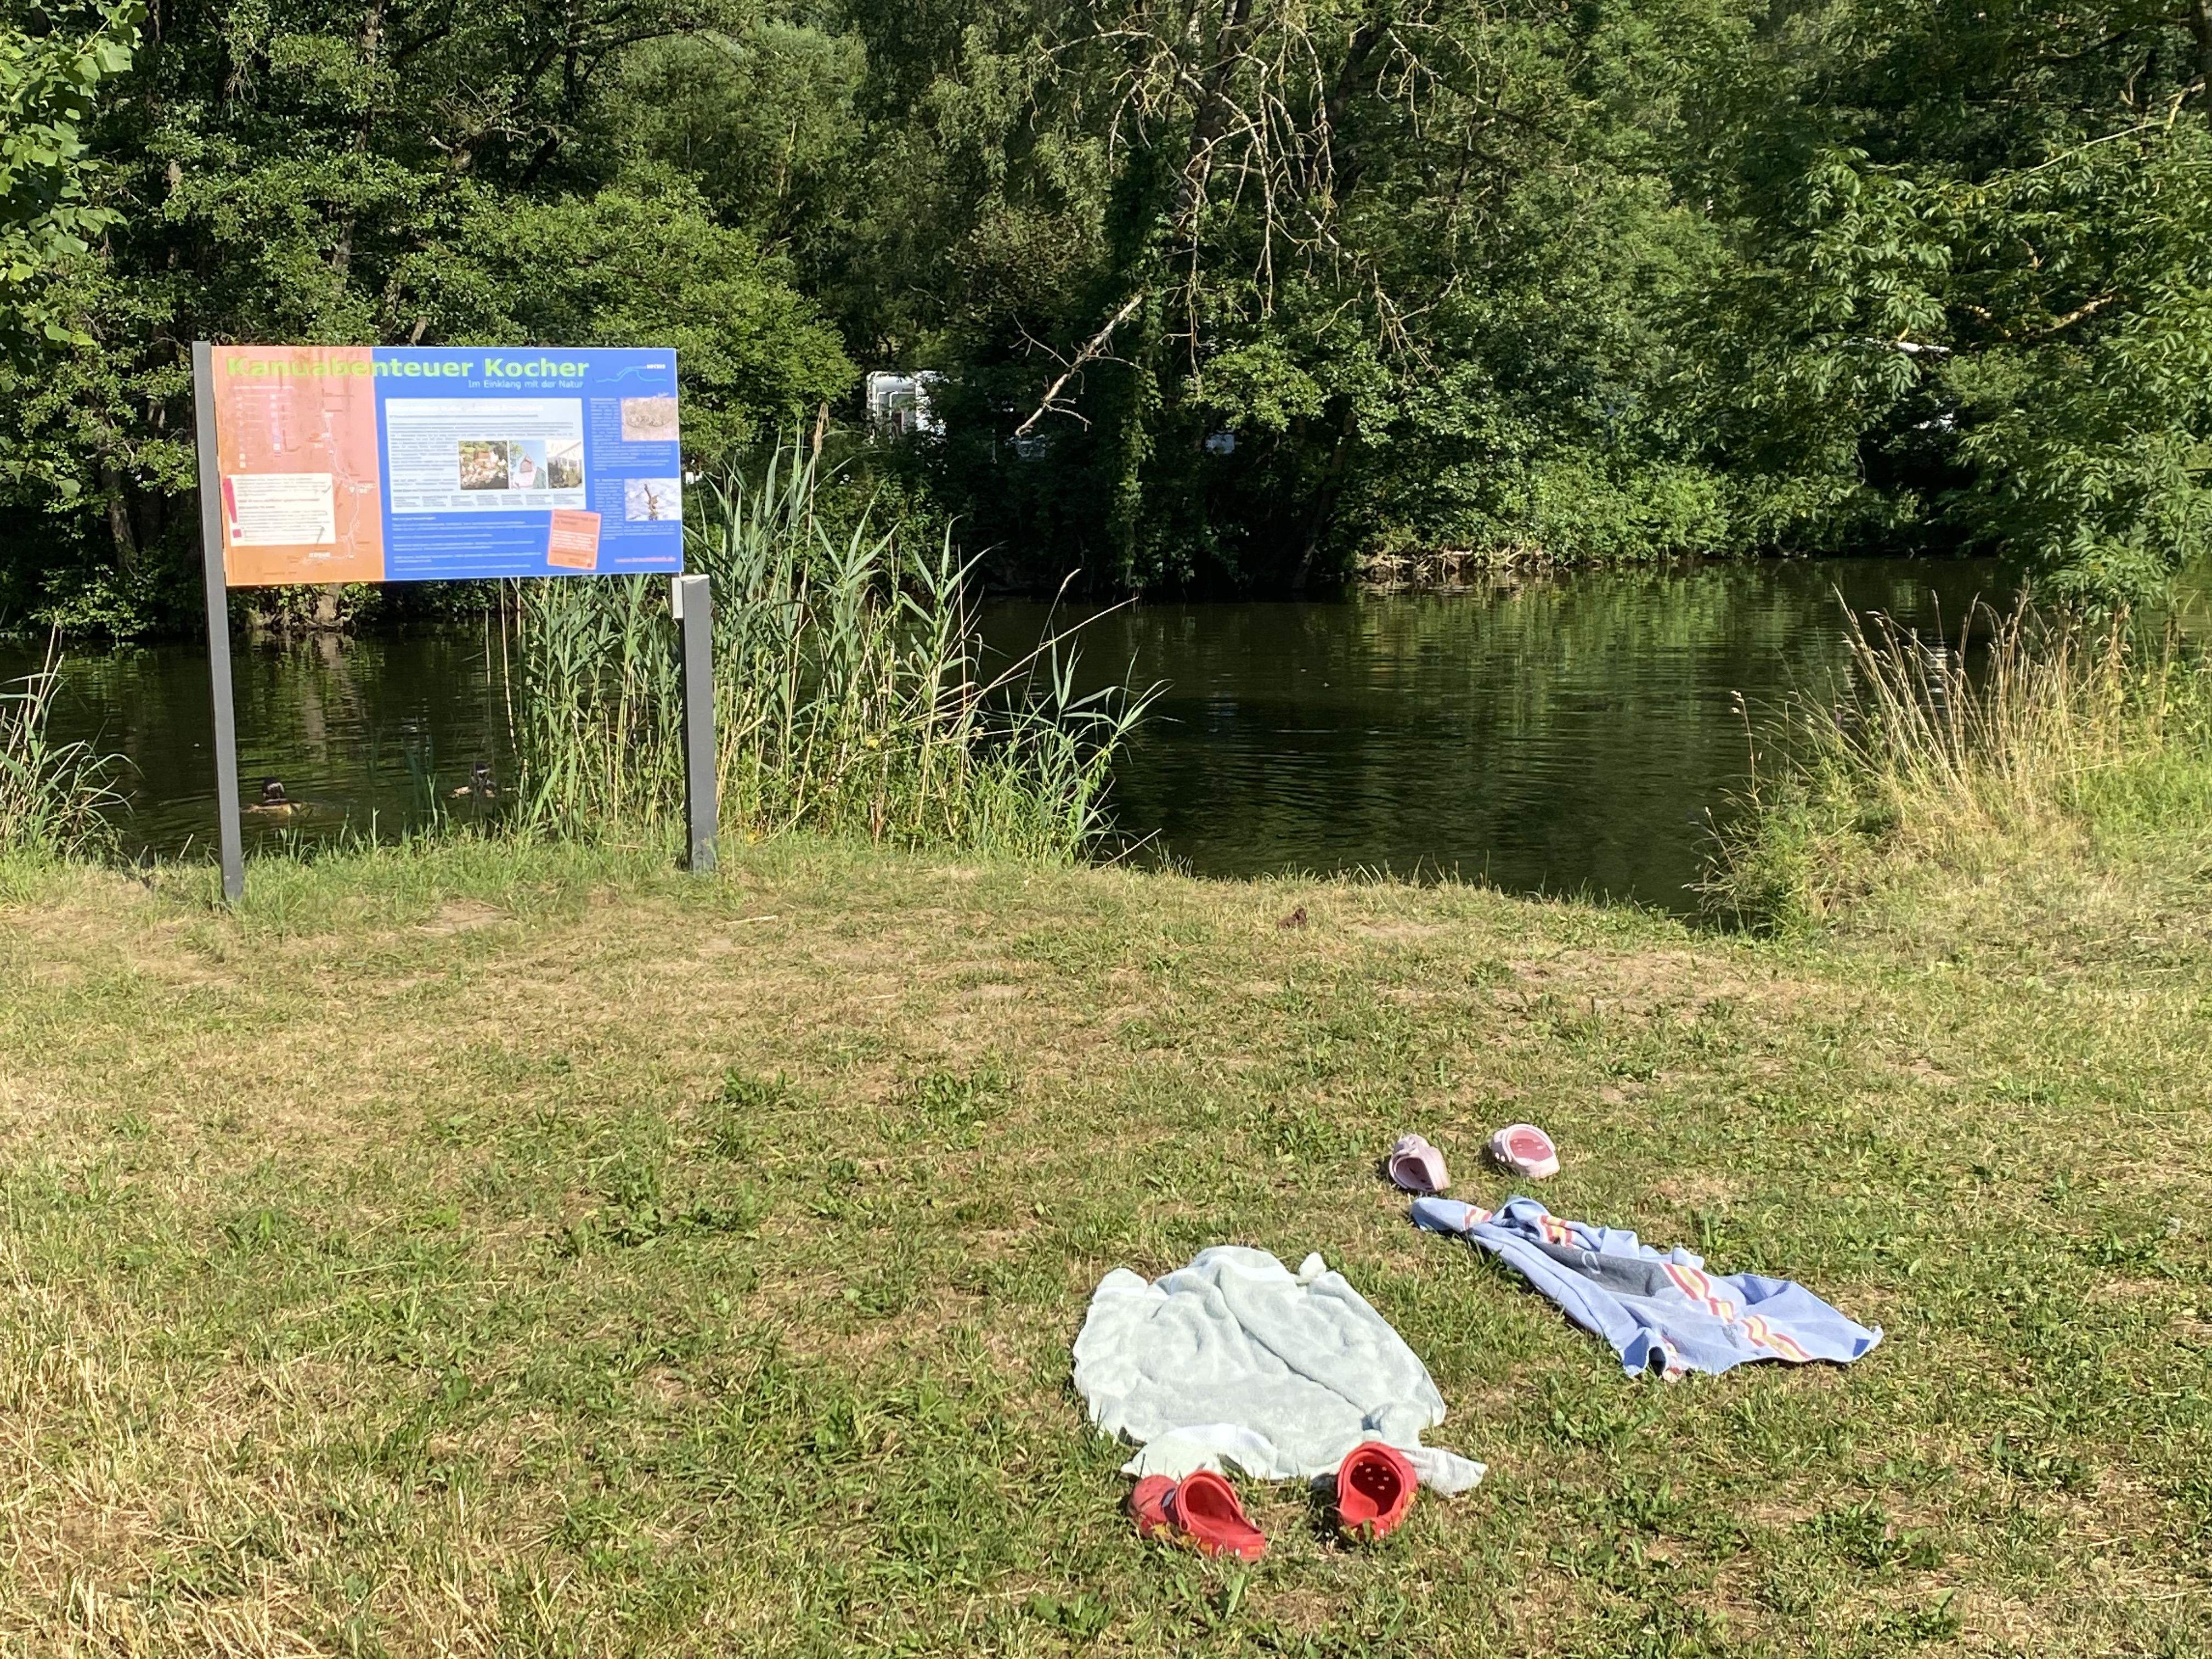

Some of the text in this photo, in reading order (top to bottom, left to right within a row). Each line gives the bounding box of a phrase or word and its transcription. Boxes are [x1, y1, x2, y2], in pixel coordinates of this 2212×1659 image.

[227, 357, 589, 377] Kanuabenteuer Kocher
[468, 379, 583, 390] Im Einklang mit der Natur
